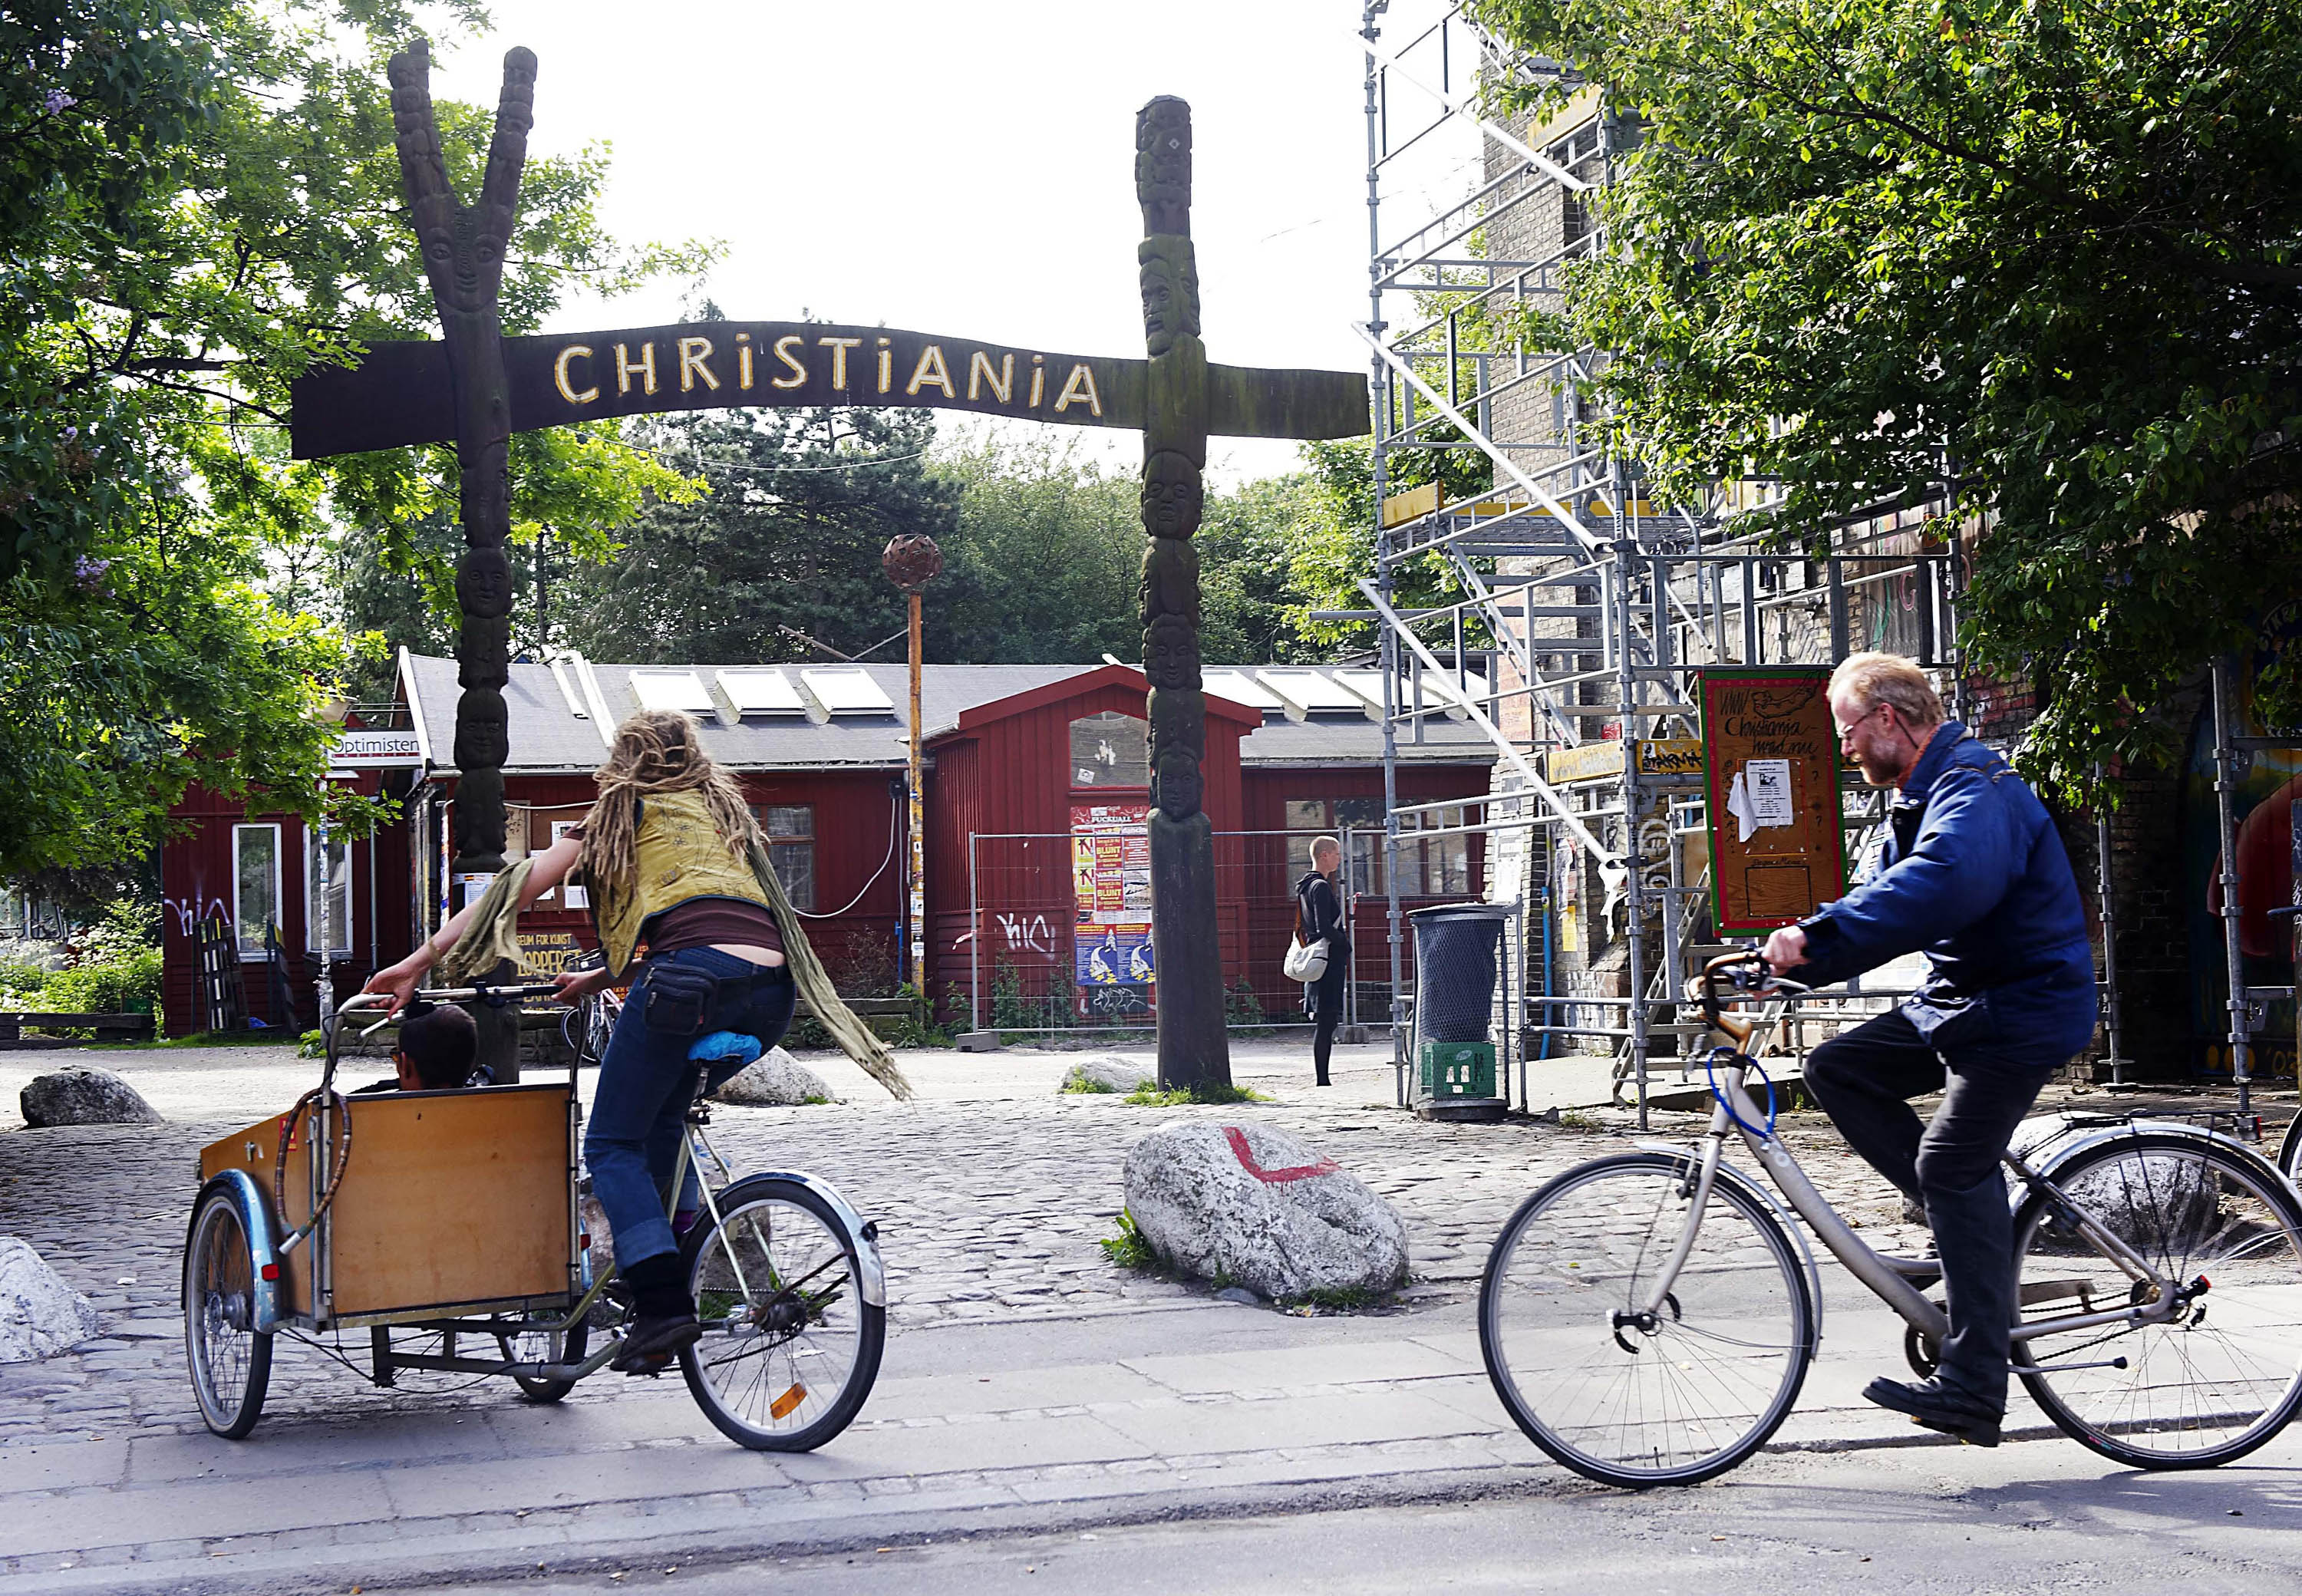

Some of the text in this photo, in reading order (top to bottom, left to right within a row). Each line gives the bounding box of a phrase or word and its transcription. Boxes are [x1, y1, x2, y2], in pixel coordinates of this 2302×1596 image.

[334, 737, 420, 753] Optimisten
[516, 934, 572, 945] SEUM FOR KUNST
